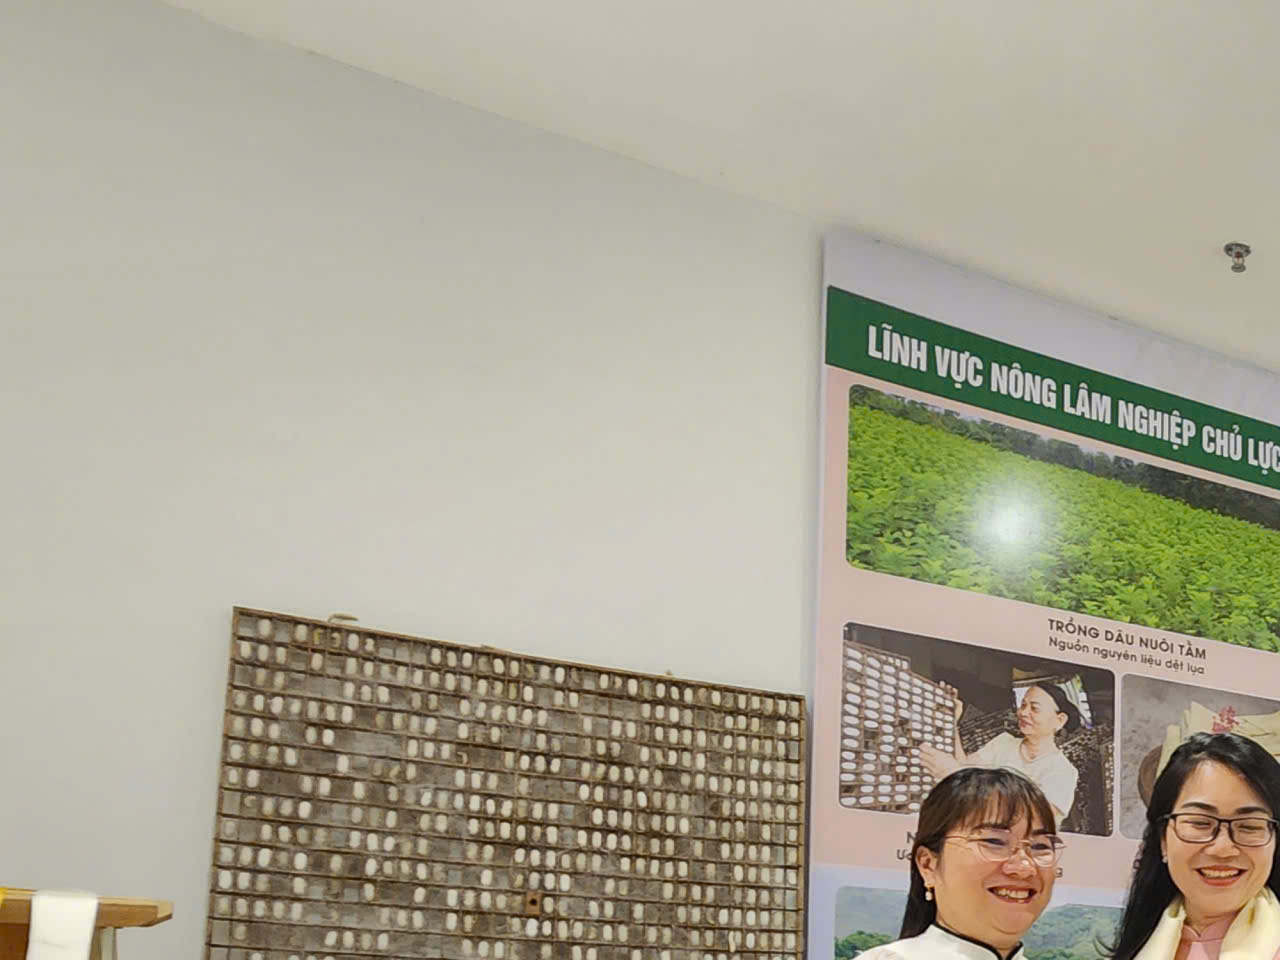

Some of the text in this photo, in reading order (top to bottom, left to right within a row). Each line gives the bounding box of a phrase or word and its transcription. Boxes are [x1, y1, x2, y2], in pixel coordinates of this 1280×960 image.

[867, 323, 927, 372] LĨNH
[935, 345, 983, 390] VỰC
[990, 363, 1057, 409] NÔNG
[1063, 382, 1112, 425] LÂM
[1117, 403, 1196, 450] NGHIỆP
[1202, 424, 1243, 462] CHỦ
[1104, 629, 1135, 646] DÂU
[1139, 637, 1174, 654] NUÔI
[1178, 640, 1207, 660] TẰM
[1093, 647, 1137, 662] nguyên
[1141, 653, 1162, 669] liệu
[1165, 657, 1184, 673] dệt
[1187, 664, 1205, 676] lụa
